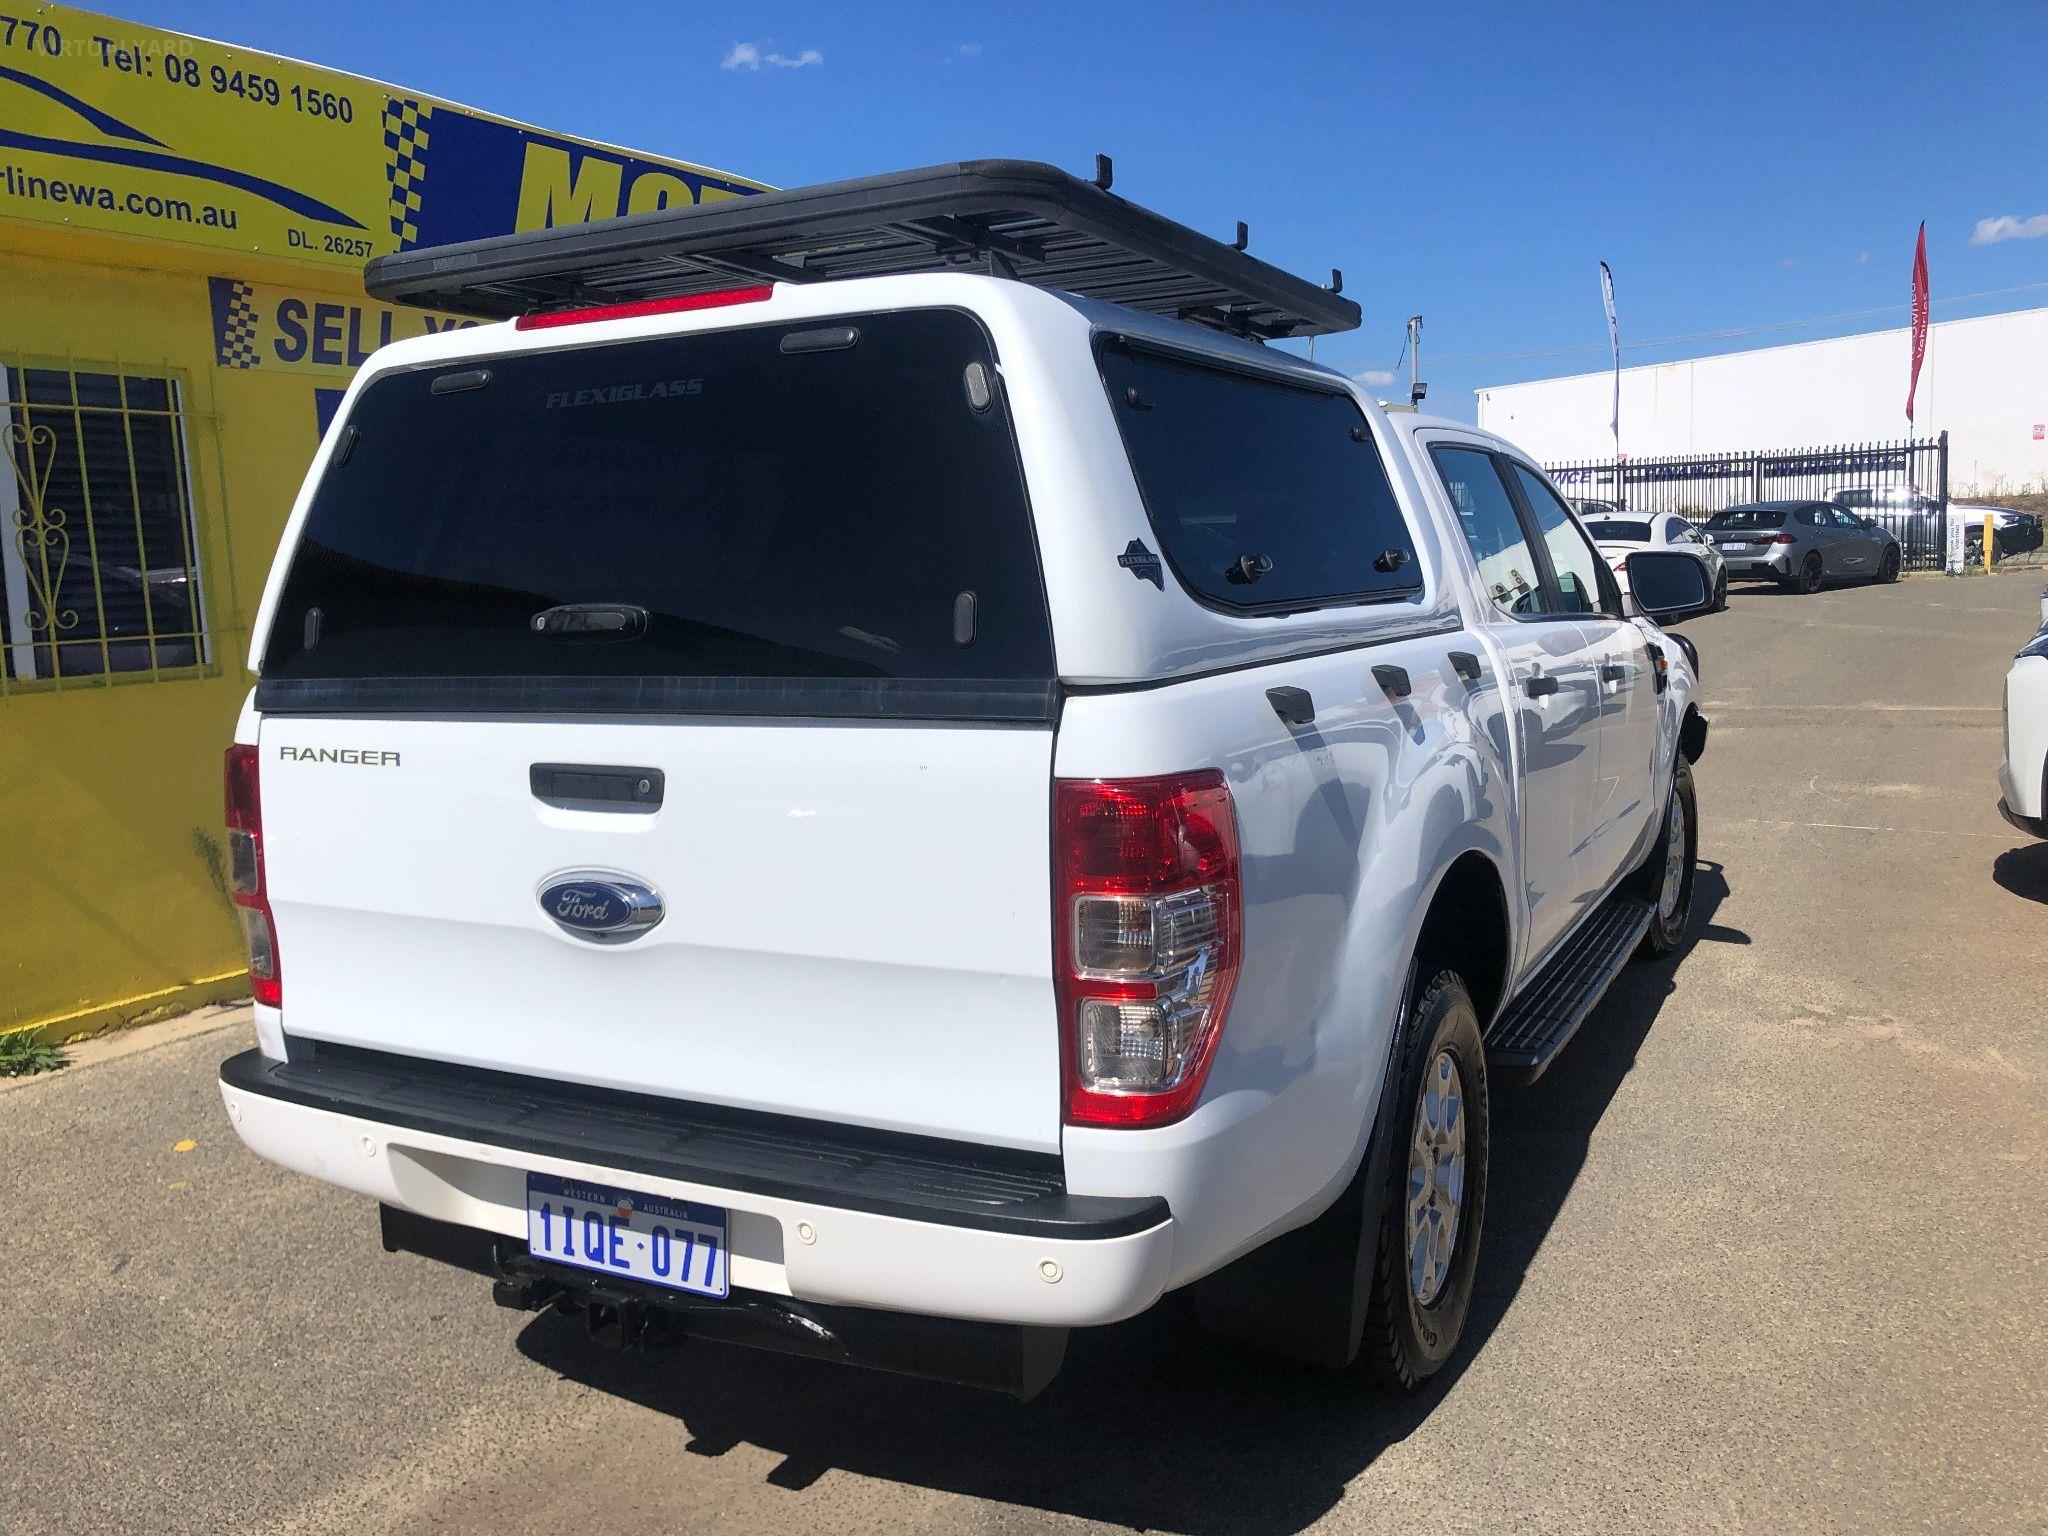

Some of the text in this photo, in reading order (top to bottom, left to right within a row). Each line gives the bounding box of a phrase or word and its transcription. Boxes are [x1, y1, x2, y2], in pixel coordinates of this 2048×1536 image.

[0, 16, 352, 123] 770 Tel: 08 9459 1560
[288, 229, 373, 258] DL. 26257
[546, 378, 704, 409] FLEXIGLASS
[280, 746, 401, 767] RANGER
[557, 889, 609, 921] Ford
[563, 1189, 689, 1220] WESTERN AUSTRALIA
